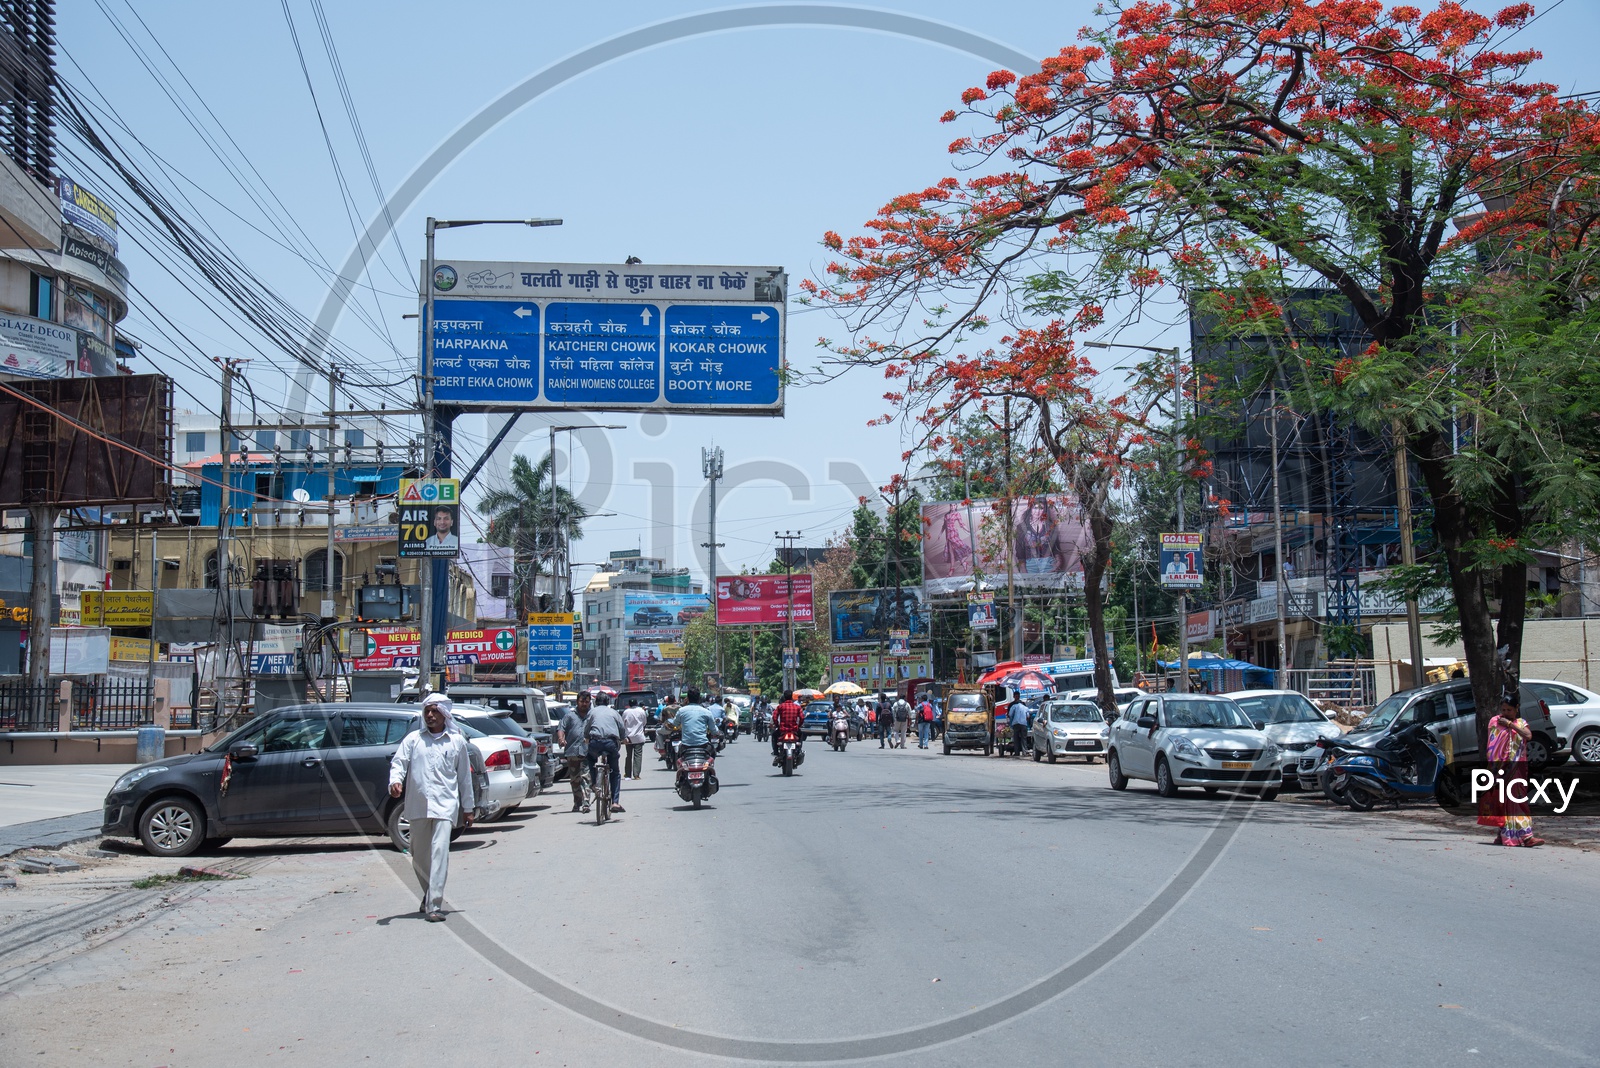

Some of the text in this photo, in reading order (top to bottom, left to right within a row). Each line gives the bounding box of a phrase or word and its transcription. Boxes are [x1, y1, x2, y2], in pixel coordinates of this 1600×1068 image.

[68, 242, 96, 263] Aptech
[520, 269, 748, 293] चलती गाड़ी से कुड़ा बाहर ना फेकें
[0, 318, 35, 333] GLAZE
[38, 326, 72, 342] DECOR
[550, 319, 627, 334] कचहरी चौक
[670, 321, 741, 335] कोकर चौक
[432, 339, 508, 350] HARPAKNA
[548, 341, 656, 352] KATCHERI CHOWK
[670, 343, 767, 354] KOKAR CHOWK
[468, 358, 499, 371] एक्का
[504, 354, 531, 369] चौक
[580, 357, 614, 372] महिला
[619, 357, 655, 371] कॉलेज
[670, 358, 693, 376] बुटी
[433, 377, 533, 388] LBERT EKKA CHOWK
[548, 378, 655, 390] RANCHI WOMENS COLLEGE
[669, 381, 752, 391] BOOTY MORE
[402, 510, 429, 521] AIR
[401, 524, 428, 541] 70
[1185, 552, 1198, 574] 1
[60, 610, 80, 619] LUCKY
[554, 613, 564, 622] चौक
[985, 604, 992, 619] 1
[1198, 622, 1208, 634] Bank
[452, 631, 483, 639] MEDICO
[901, 639, 906, 650] 1
[556, 658, 568, 666] चौक
[848, 667, 855, 677] 1
